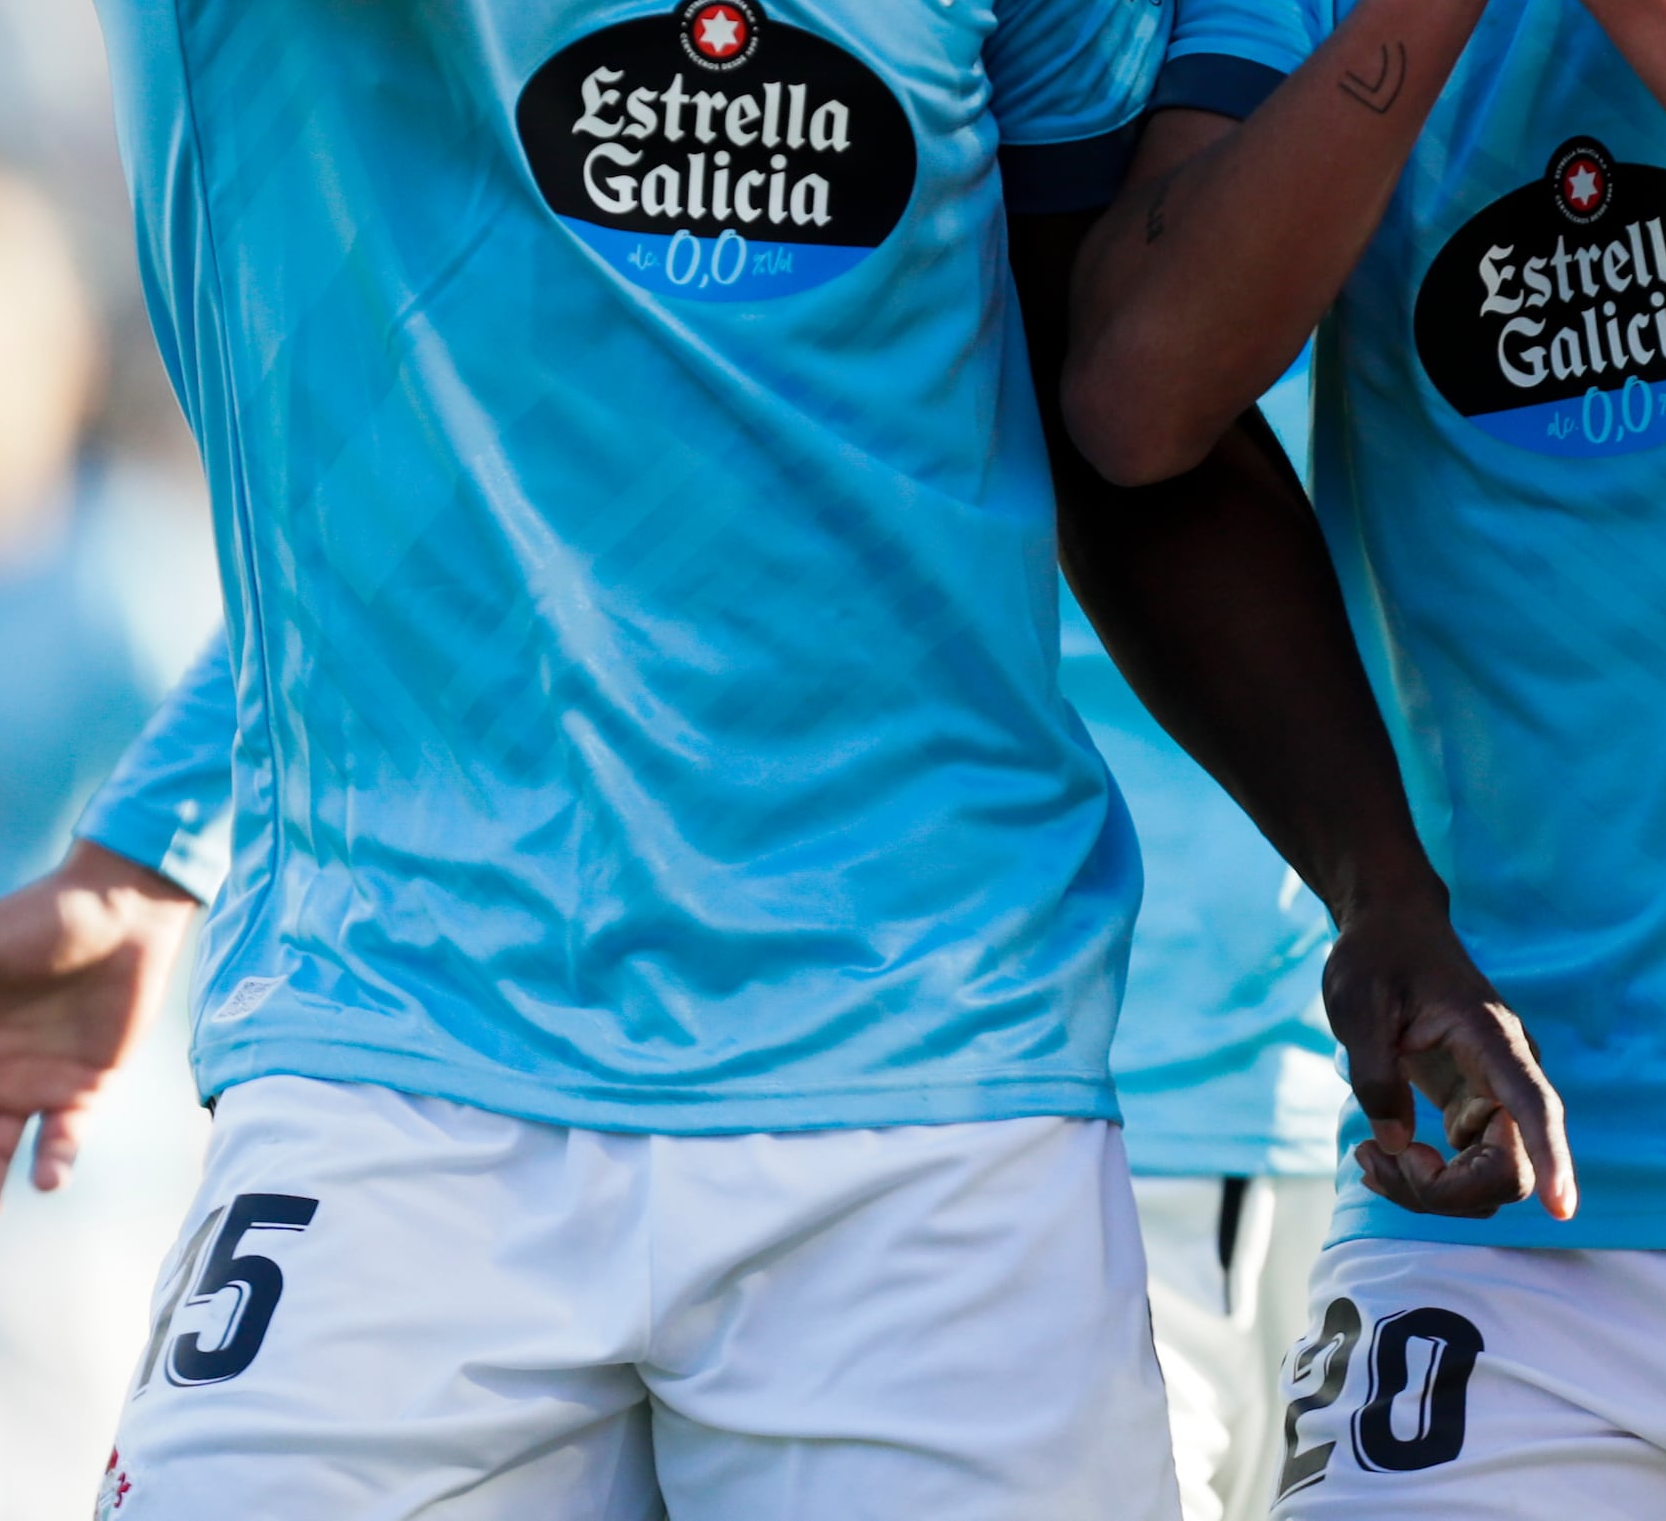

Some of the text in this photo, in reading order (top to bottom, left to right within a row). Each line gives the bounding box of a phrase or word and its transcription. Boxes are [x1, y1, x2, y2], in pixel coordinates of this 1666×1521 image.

[571, 65, 852, 153] Estrella
[583, 142, 833, 227] Galicia
[665, 229, 748, 289] 0,0
[1583, 375, 1654, 445] 0,0
[1270, 1296, 1486, 1513] 20
